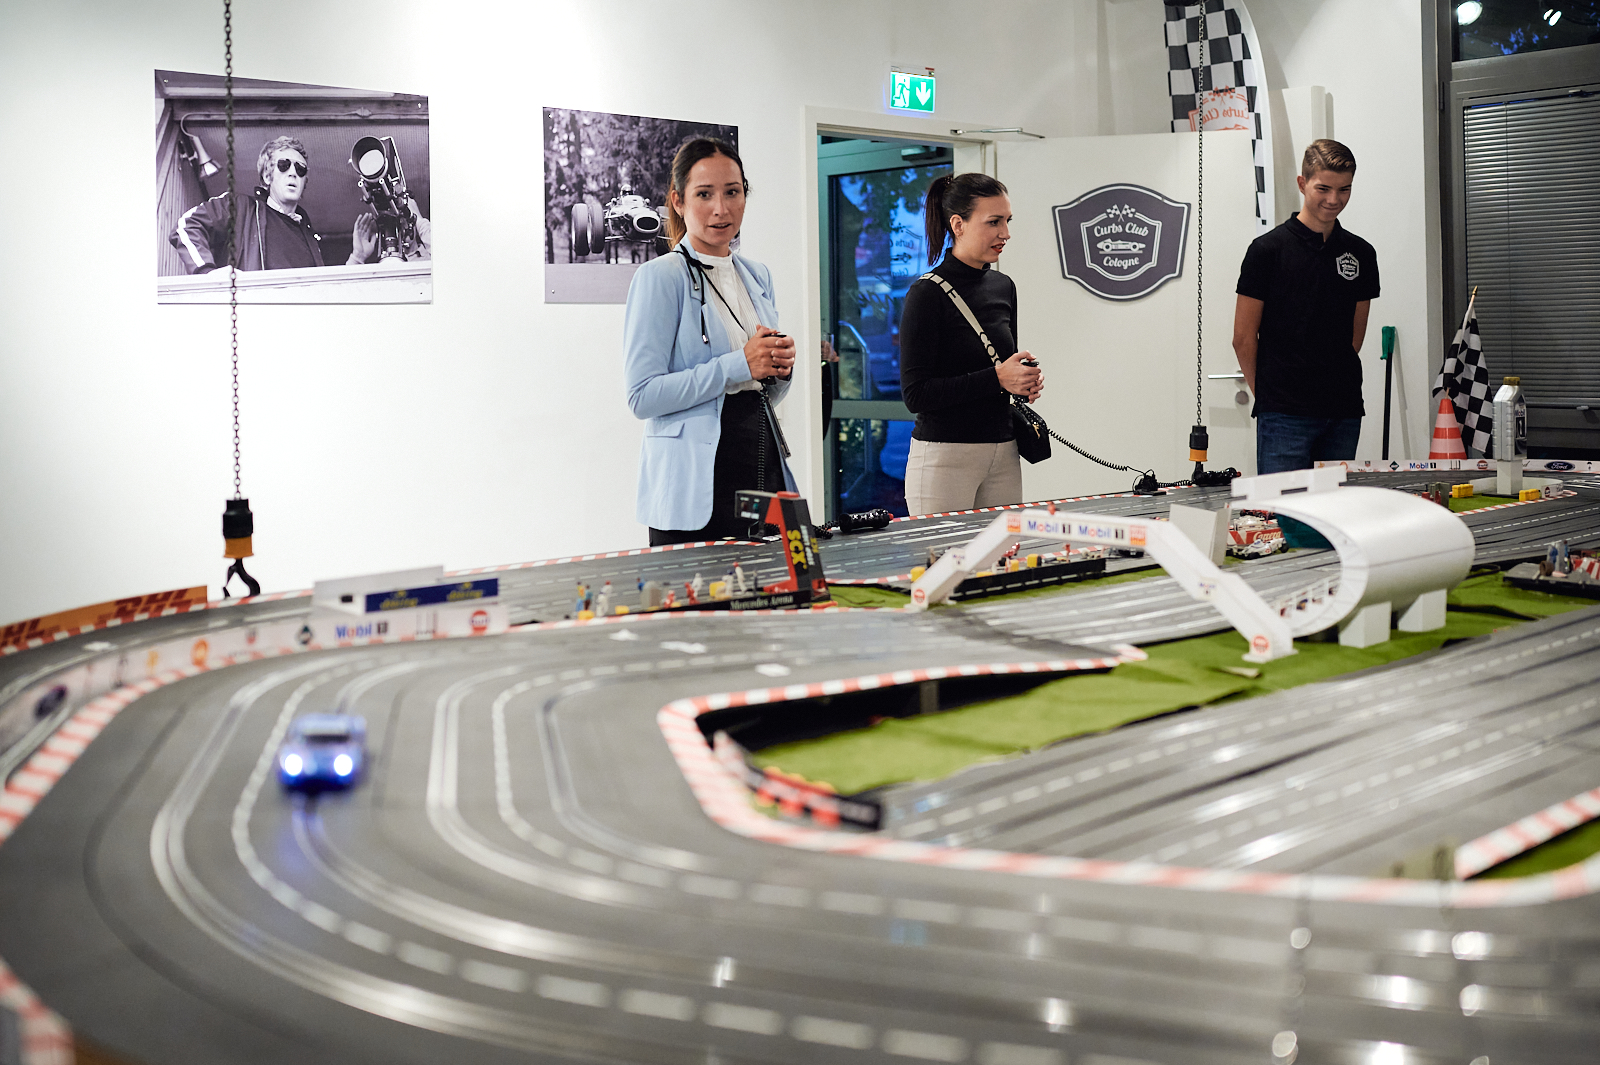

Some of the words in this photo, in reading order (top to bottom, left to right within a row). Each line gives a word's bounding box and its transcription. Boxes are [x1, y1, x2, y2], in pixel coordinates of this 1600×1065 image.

[1094, 223, 1123, 237] Curbs
[1125, 222, 1149, 236] Club
[1103, 256, 1139, 270] Cologne
[1028, 521, 1059, 533] Mobil
[1079, 525, 1111, 538] Mobil
[1253, 531, 1282, 542] Carrera
[787, 530, 807, 567] SCX
[113, 588, 193, 620] DHL
[730, 597, 769, 610] Mercedes
[770, 595, 794, 606] Arena
[335, 623, 373, 640] Mobil
